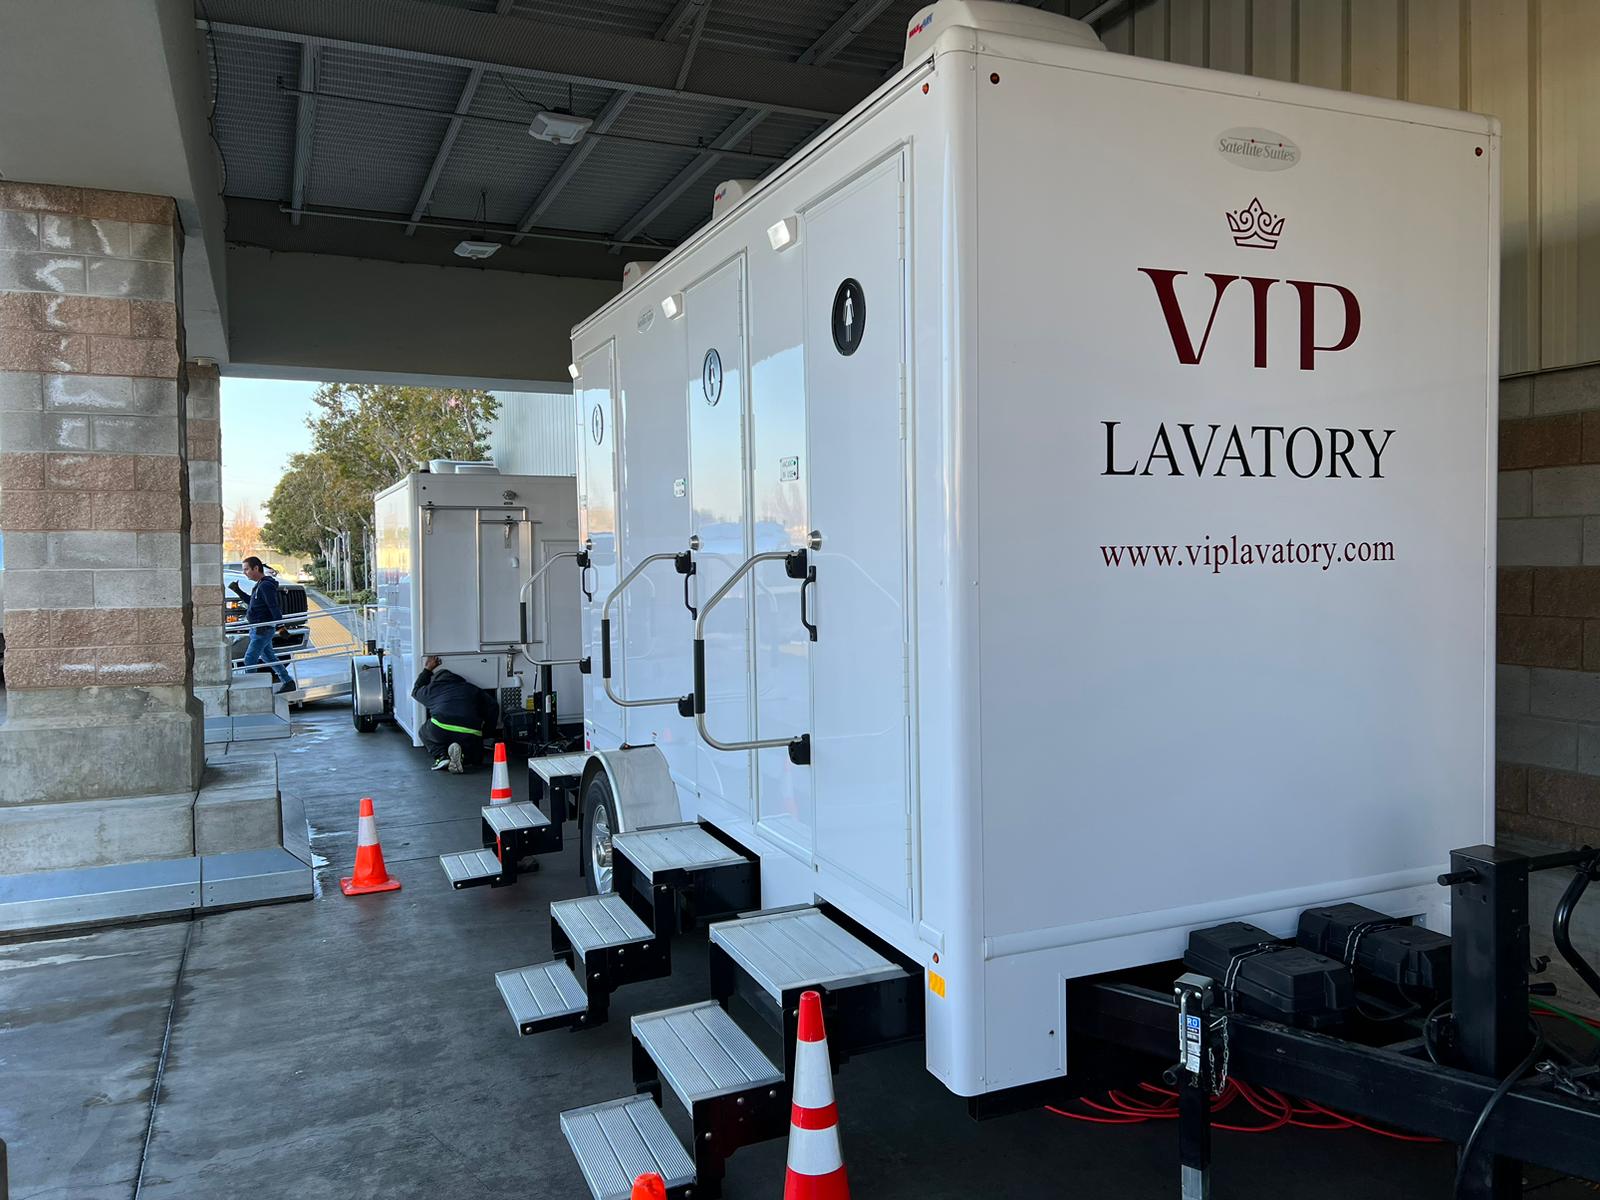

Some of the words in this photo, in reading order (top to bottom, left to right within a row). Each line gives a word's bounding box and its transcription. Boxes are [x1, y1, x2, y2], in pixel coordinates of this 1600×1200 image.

[1137, 267, 1361, 370] VIP
[1100, 420, 1396, 479] LAVATORY
[1100, 534, 1396, 574] www.viplavatory.com
